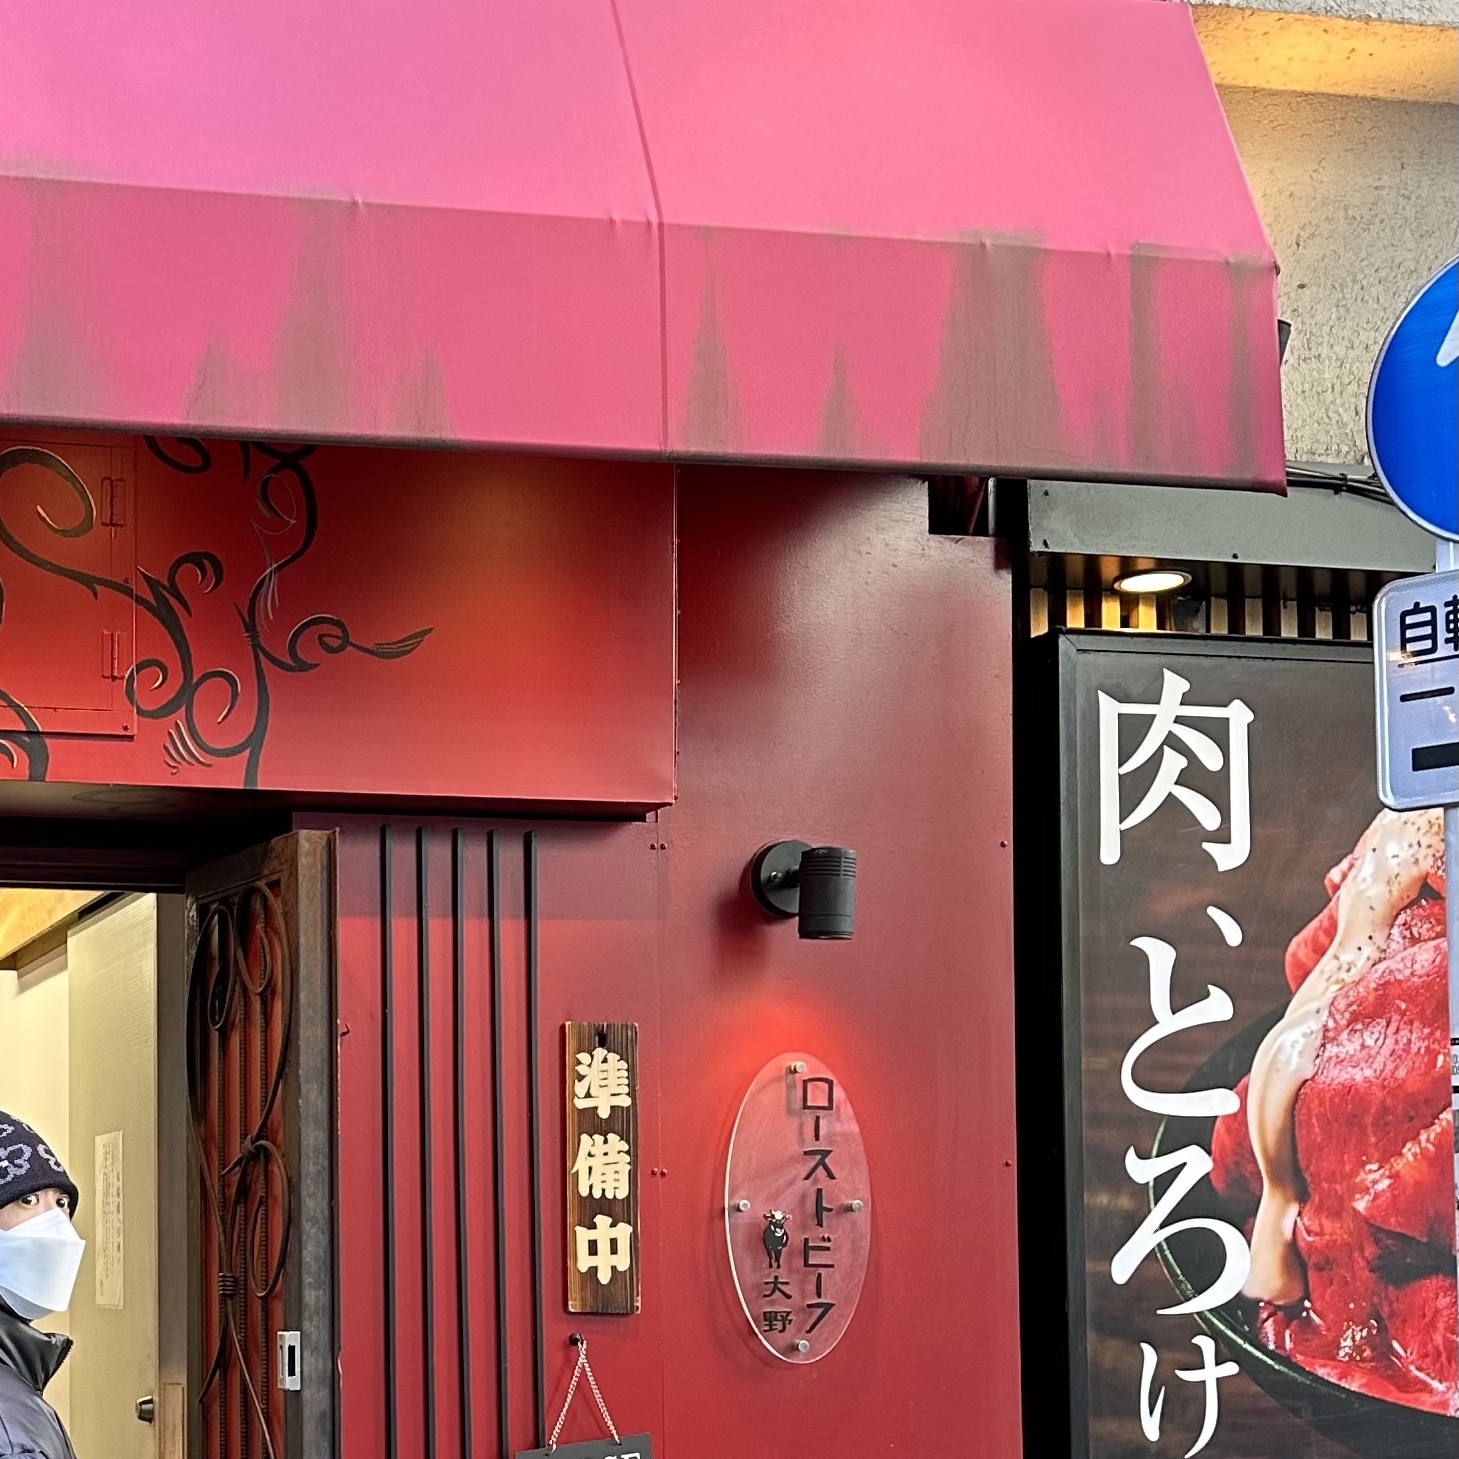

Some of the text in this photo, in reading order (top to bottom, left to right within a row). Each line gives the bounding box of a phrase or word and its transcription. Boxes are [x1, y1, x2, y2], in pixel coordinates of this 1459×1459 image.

[571, 1048, 632, 1285] 準備中
[802, 1077, 837, 1334] ローストビーフ
[762, 1275, 793, 1334] 大野
